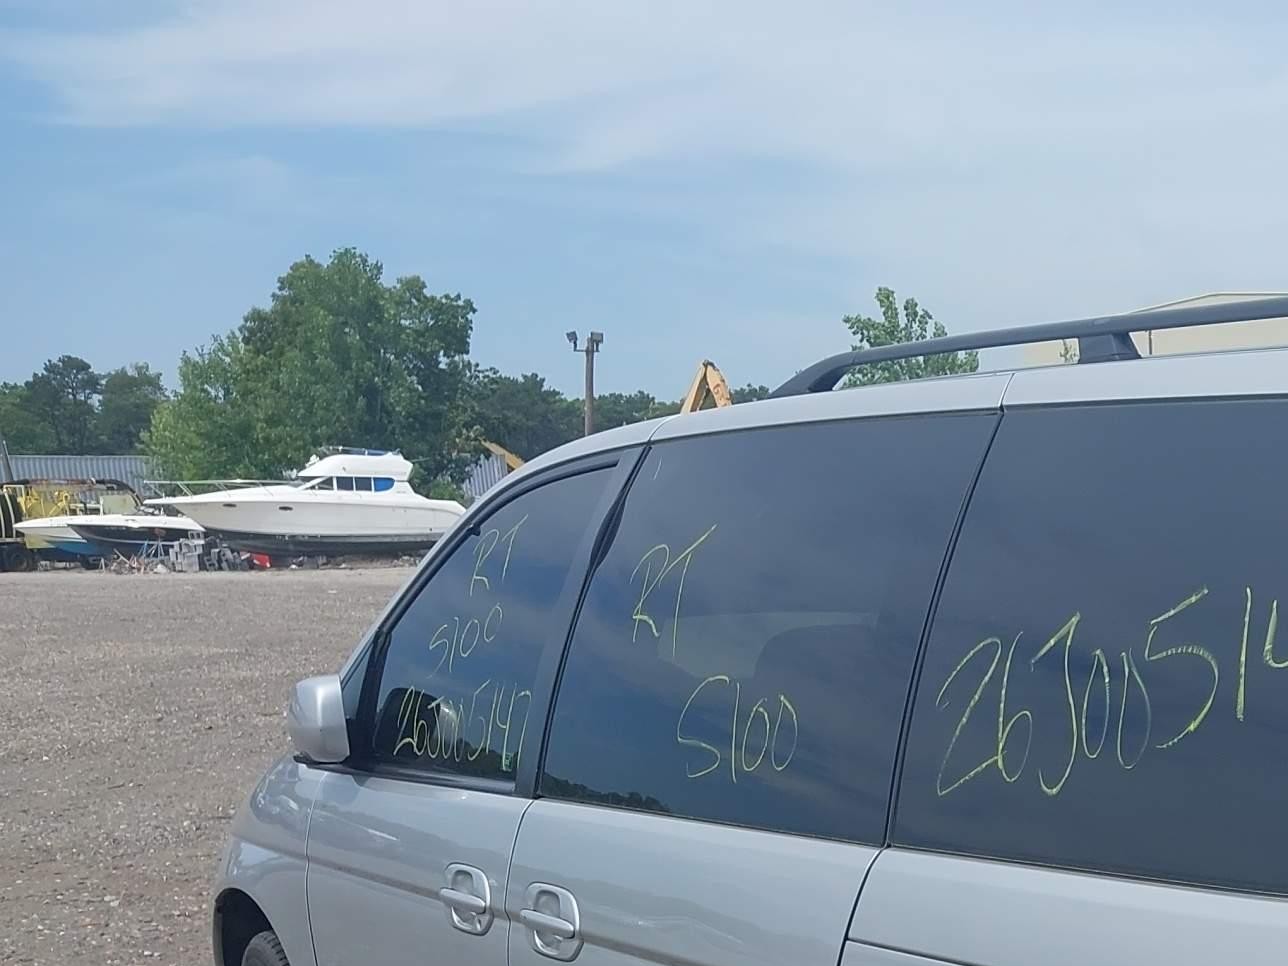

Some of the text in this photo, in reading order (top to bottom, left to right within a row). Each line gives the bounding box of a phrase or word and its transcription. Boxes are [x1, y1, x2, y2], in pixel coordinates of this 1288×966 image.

[469, 513, 529, 596] RT
[629, 524, 717, 657] RT
[392, 680, 532, 772] 26J005147
